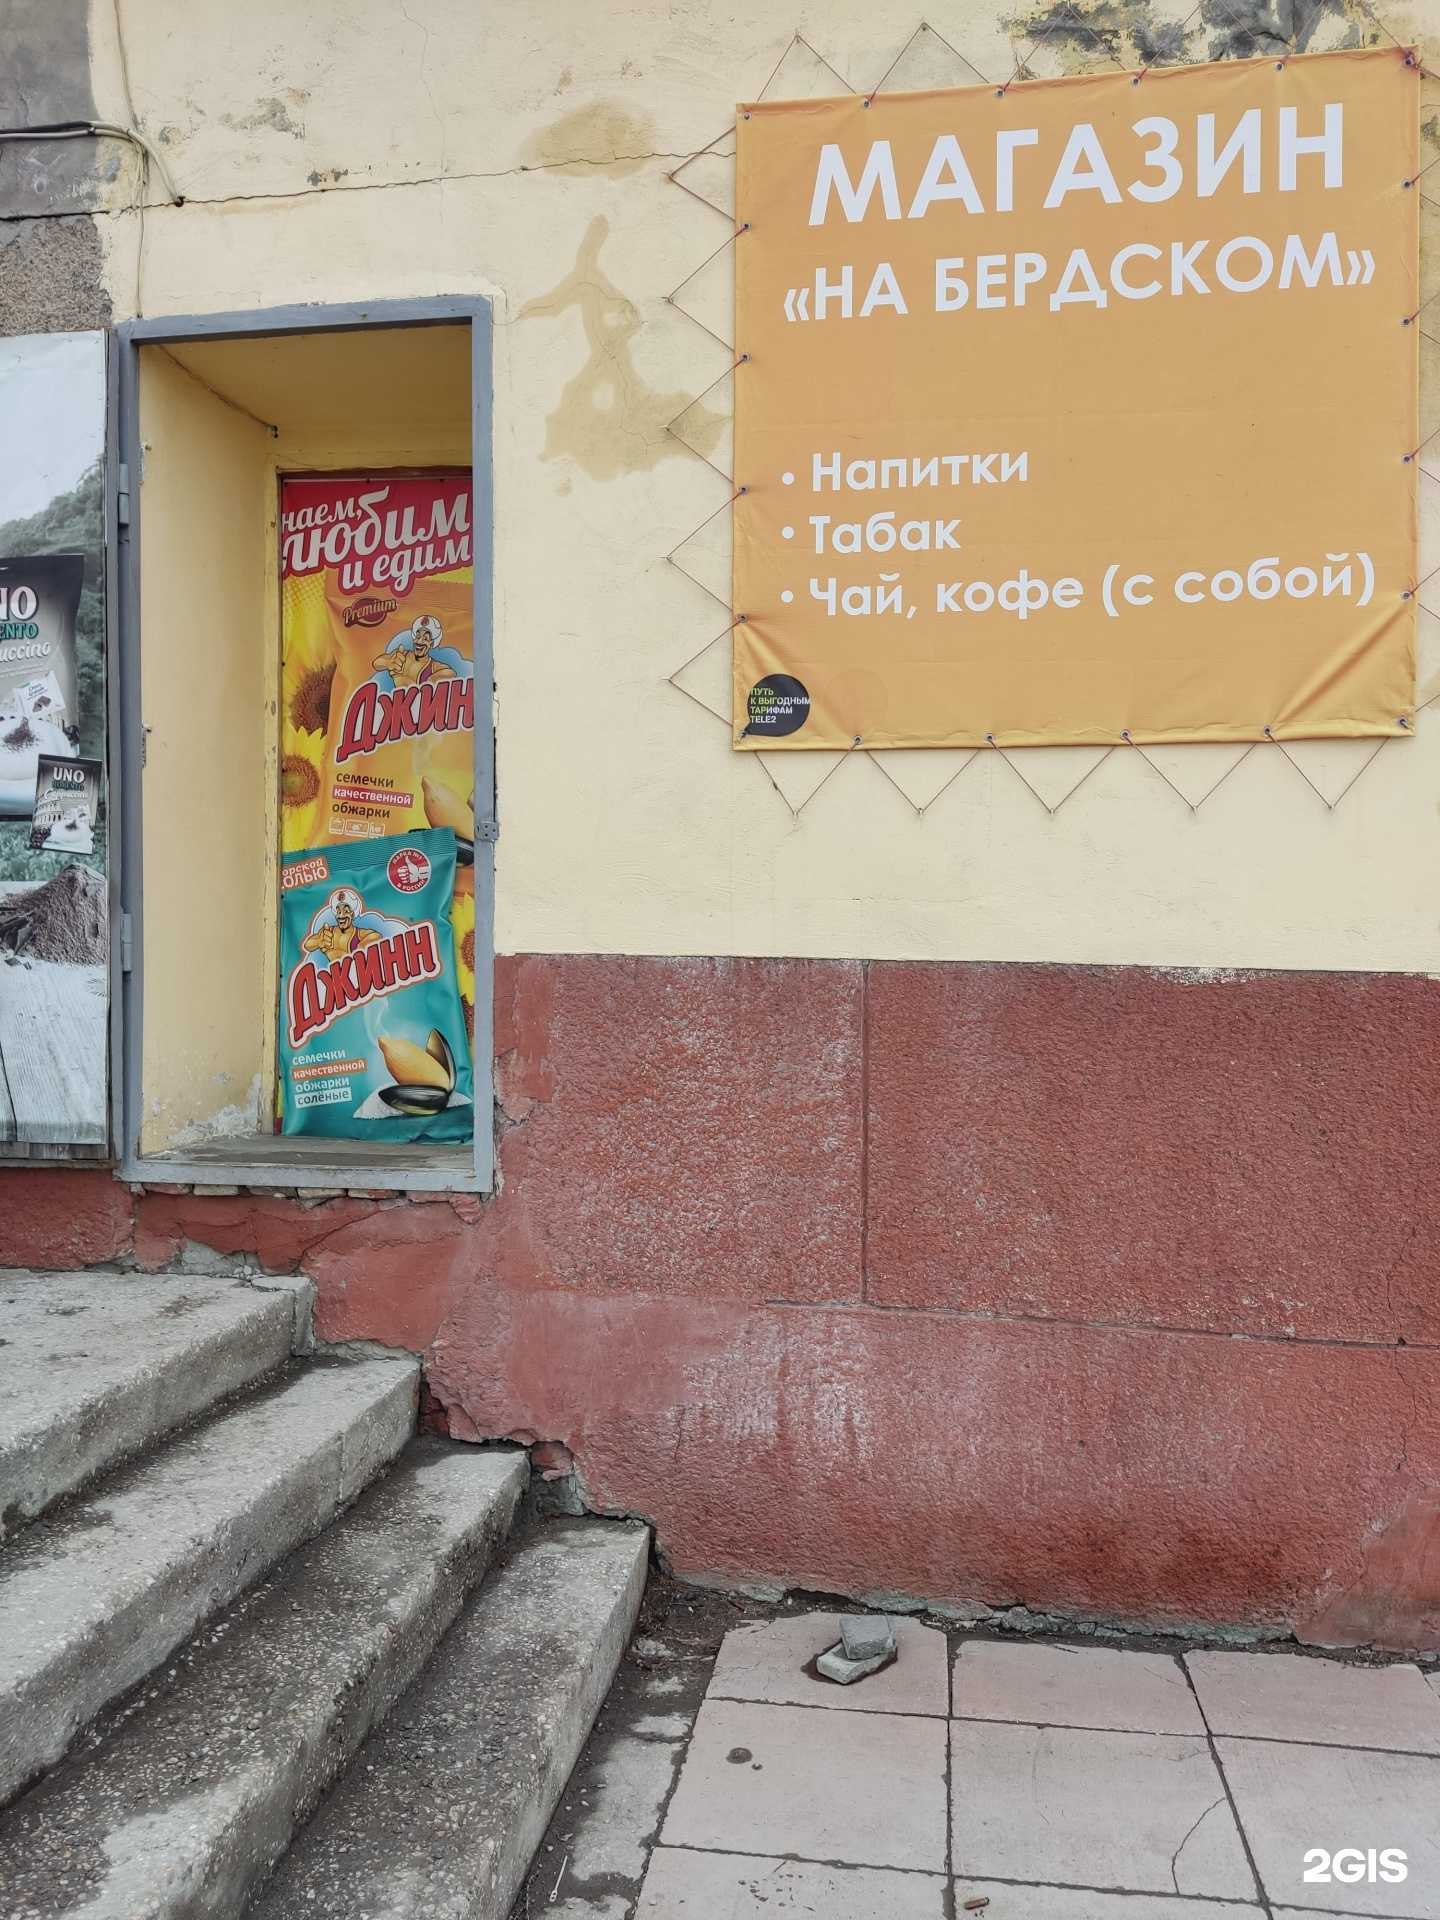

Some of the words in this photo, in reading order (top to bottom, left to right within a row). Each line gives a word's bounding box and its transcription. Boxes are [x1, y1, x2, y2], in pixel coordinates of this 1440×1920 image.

[808, 103, 1343, 226] МАГАЗИН
[783, 263, 908, 322] «НА
[935, 232, 1376, 312] БЕРДСКОМ»
[811, 452, 1029, 492] Напитки
[282, 486, 471, 572] любим
[809, 510, 962, 555] Табак
[342, 560, 364, 590] и
[372, 535, 472, 592] едим
[810, 573, 918, 619] Чай,
[936, 569, 1084, 619] кофе
[1102, 564, 1154, 617] (с
[1174, 552, 1376, 607] собой)
[343, 599, 397, 625] Premium
[751, 687, 774, 696] ПУТЬ
[751, 706, 793, 715] ТАРИФАМ
[758, 697, 810, 706] ВЫГОДНЫМ
[751, 715, 777, 723] TELE2
[53, 766, 85, 784] UNO
[336, 772, 394, 788] семечки
[334, 788, 411, 805] качественной
[332, 802, 391, 819] обжарки
[281, 866, 328, 889] ОЛЬЮ
[292, 1049, 346, 1065] семечки
[293, 1059, 365, 1080] качественной
[295, 1077, 350, 1093] обжарки
